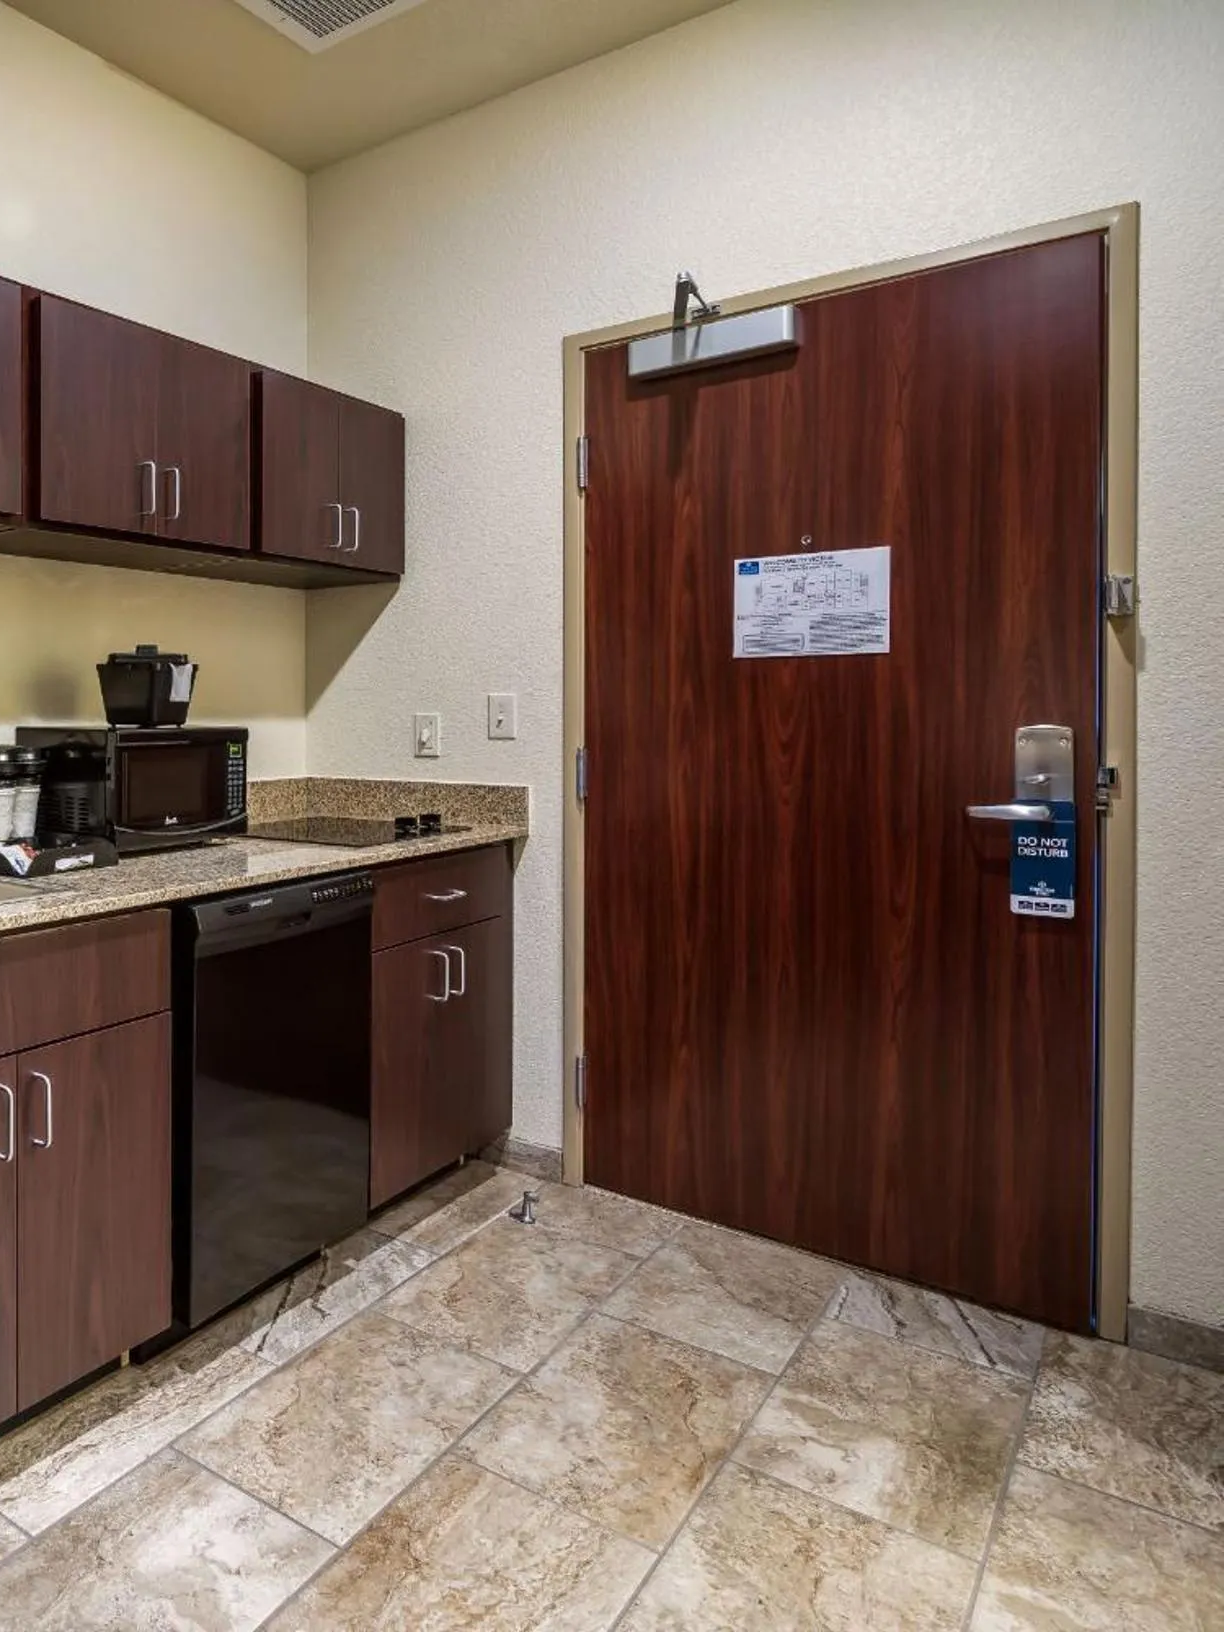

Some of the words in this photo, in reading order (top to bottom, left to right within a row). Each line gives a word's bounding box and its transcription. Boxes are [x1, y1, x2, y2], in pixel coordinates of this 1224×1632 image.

[1017, 836, 1037, 846] DO
[1041, 838, 1069, 848] NOT
[1017, 847, 1069, 858] DISTURB
